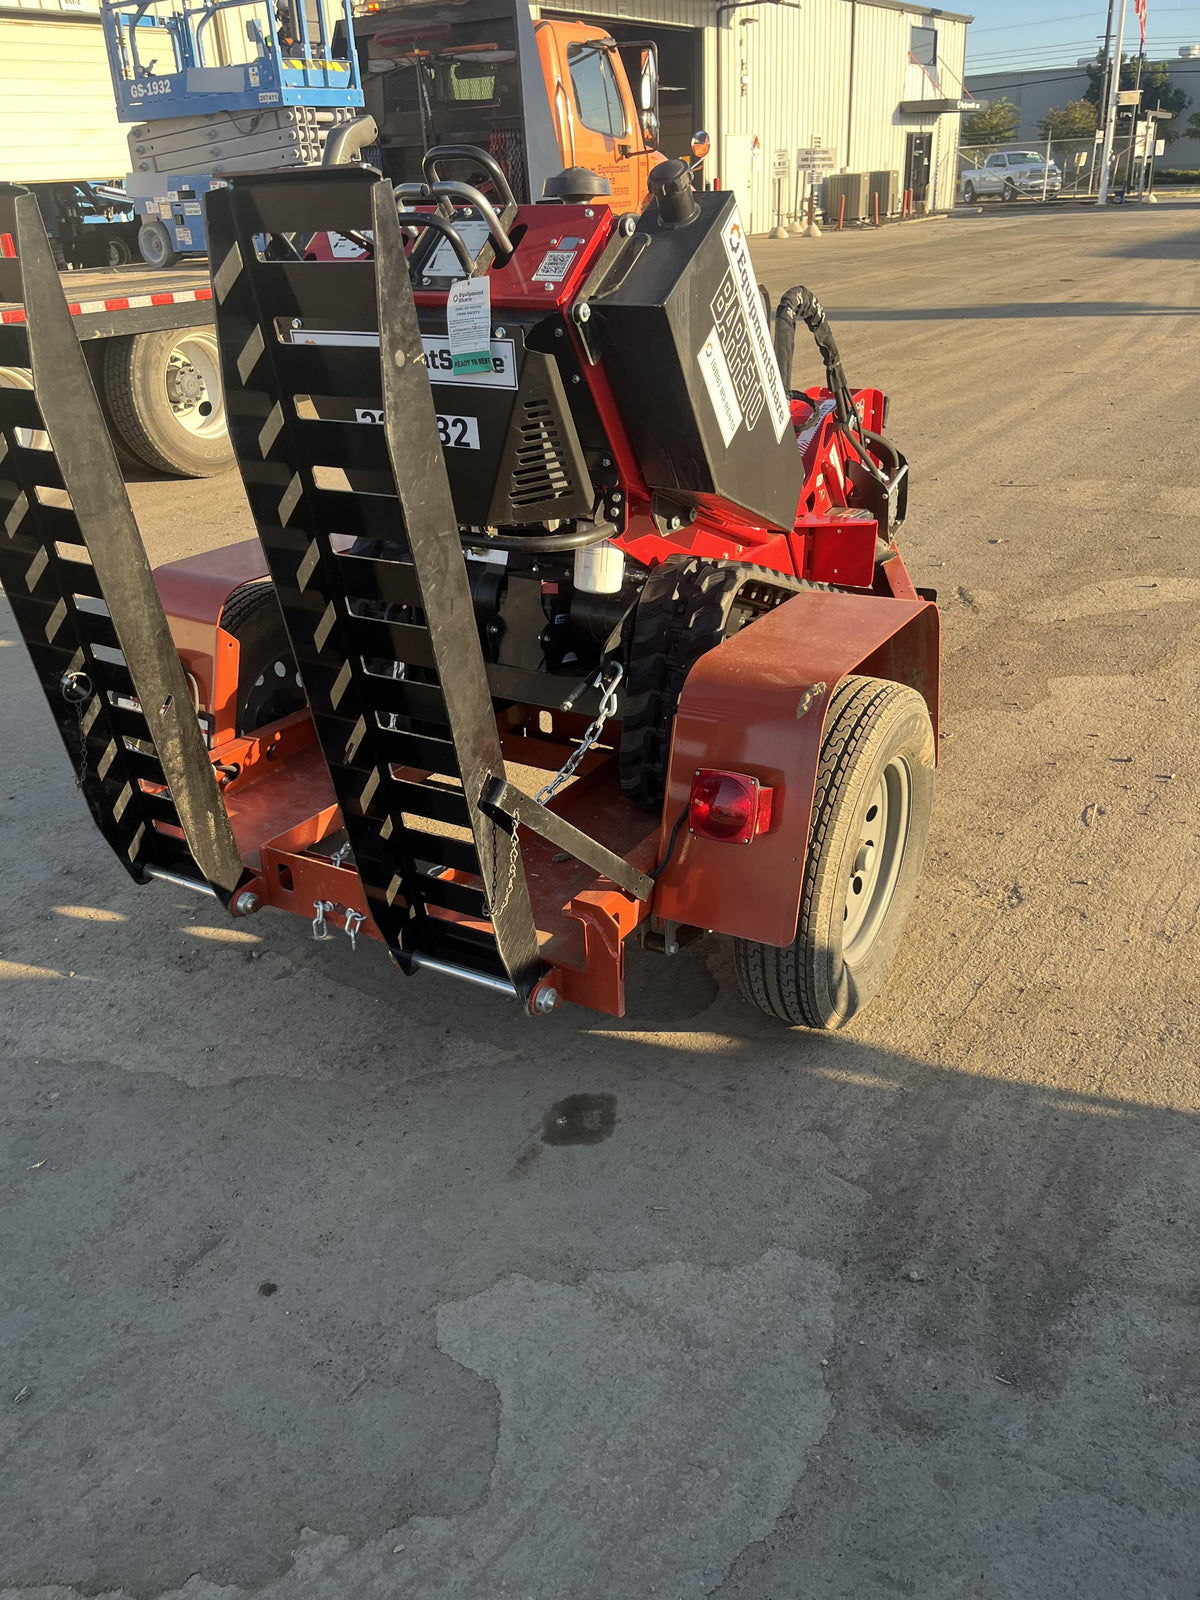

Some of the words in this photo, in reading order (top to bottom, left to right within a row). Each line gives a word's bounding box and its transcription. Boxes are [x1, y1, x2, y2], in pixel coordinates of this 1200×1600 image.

[130, 79, 172, 98] GS-1932
[458, 289, 484, 299] Equipment
[710, 265, 766, 431] BARRETO
[737, 249, 786, 425] EquipmentShare
[454, 360, 470, 368] READY
[471, 358, 478, 366] TO
[478, 357, 491, 365] RENT
[710, 358, 722, 388] (888)
